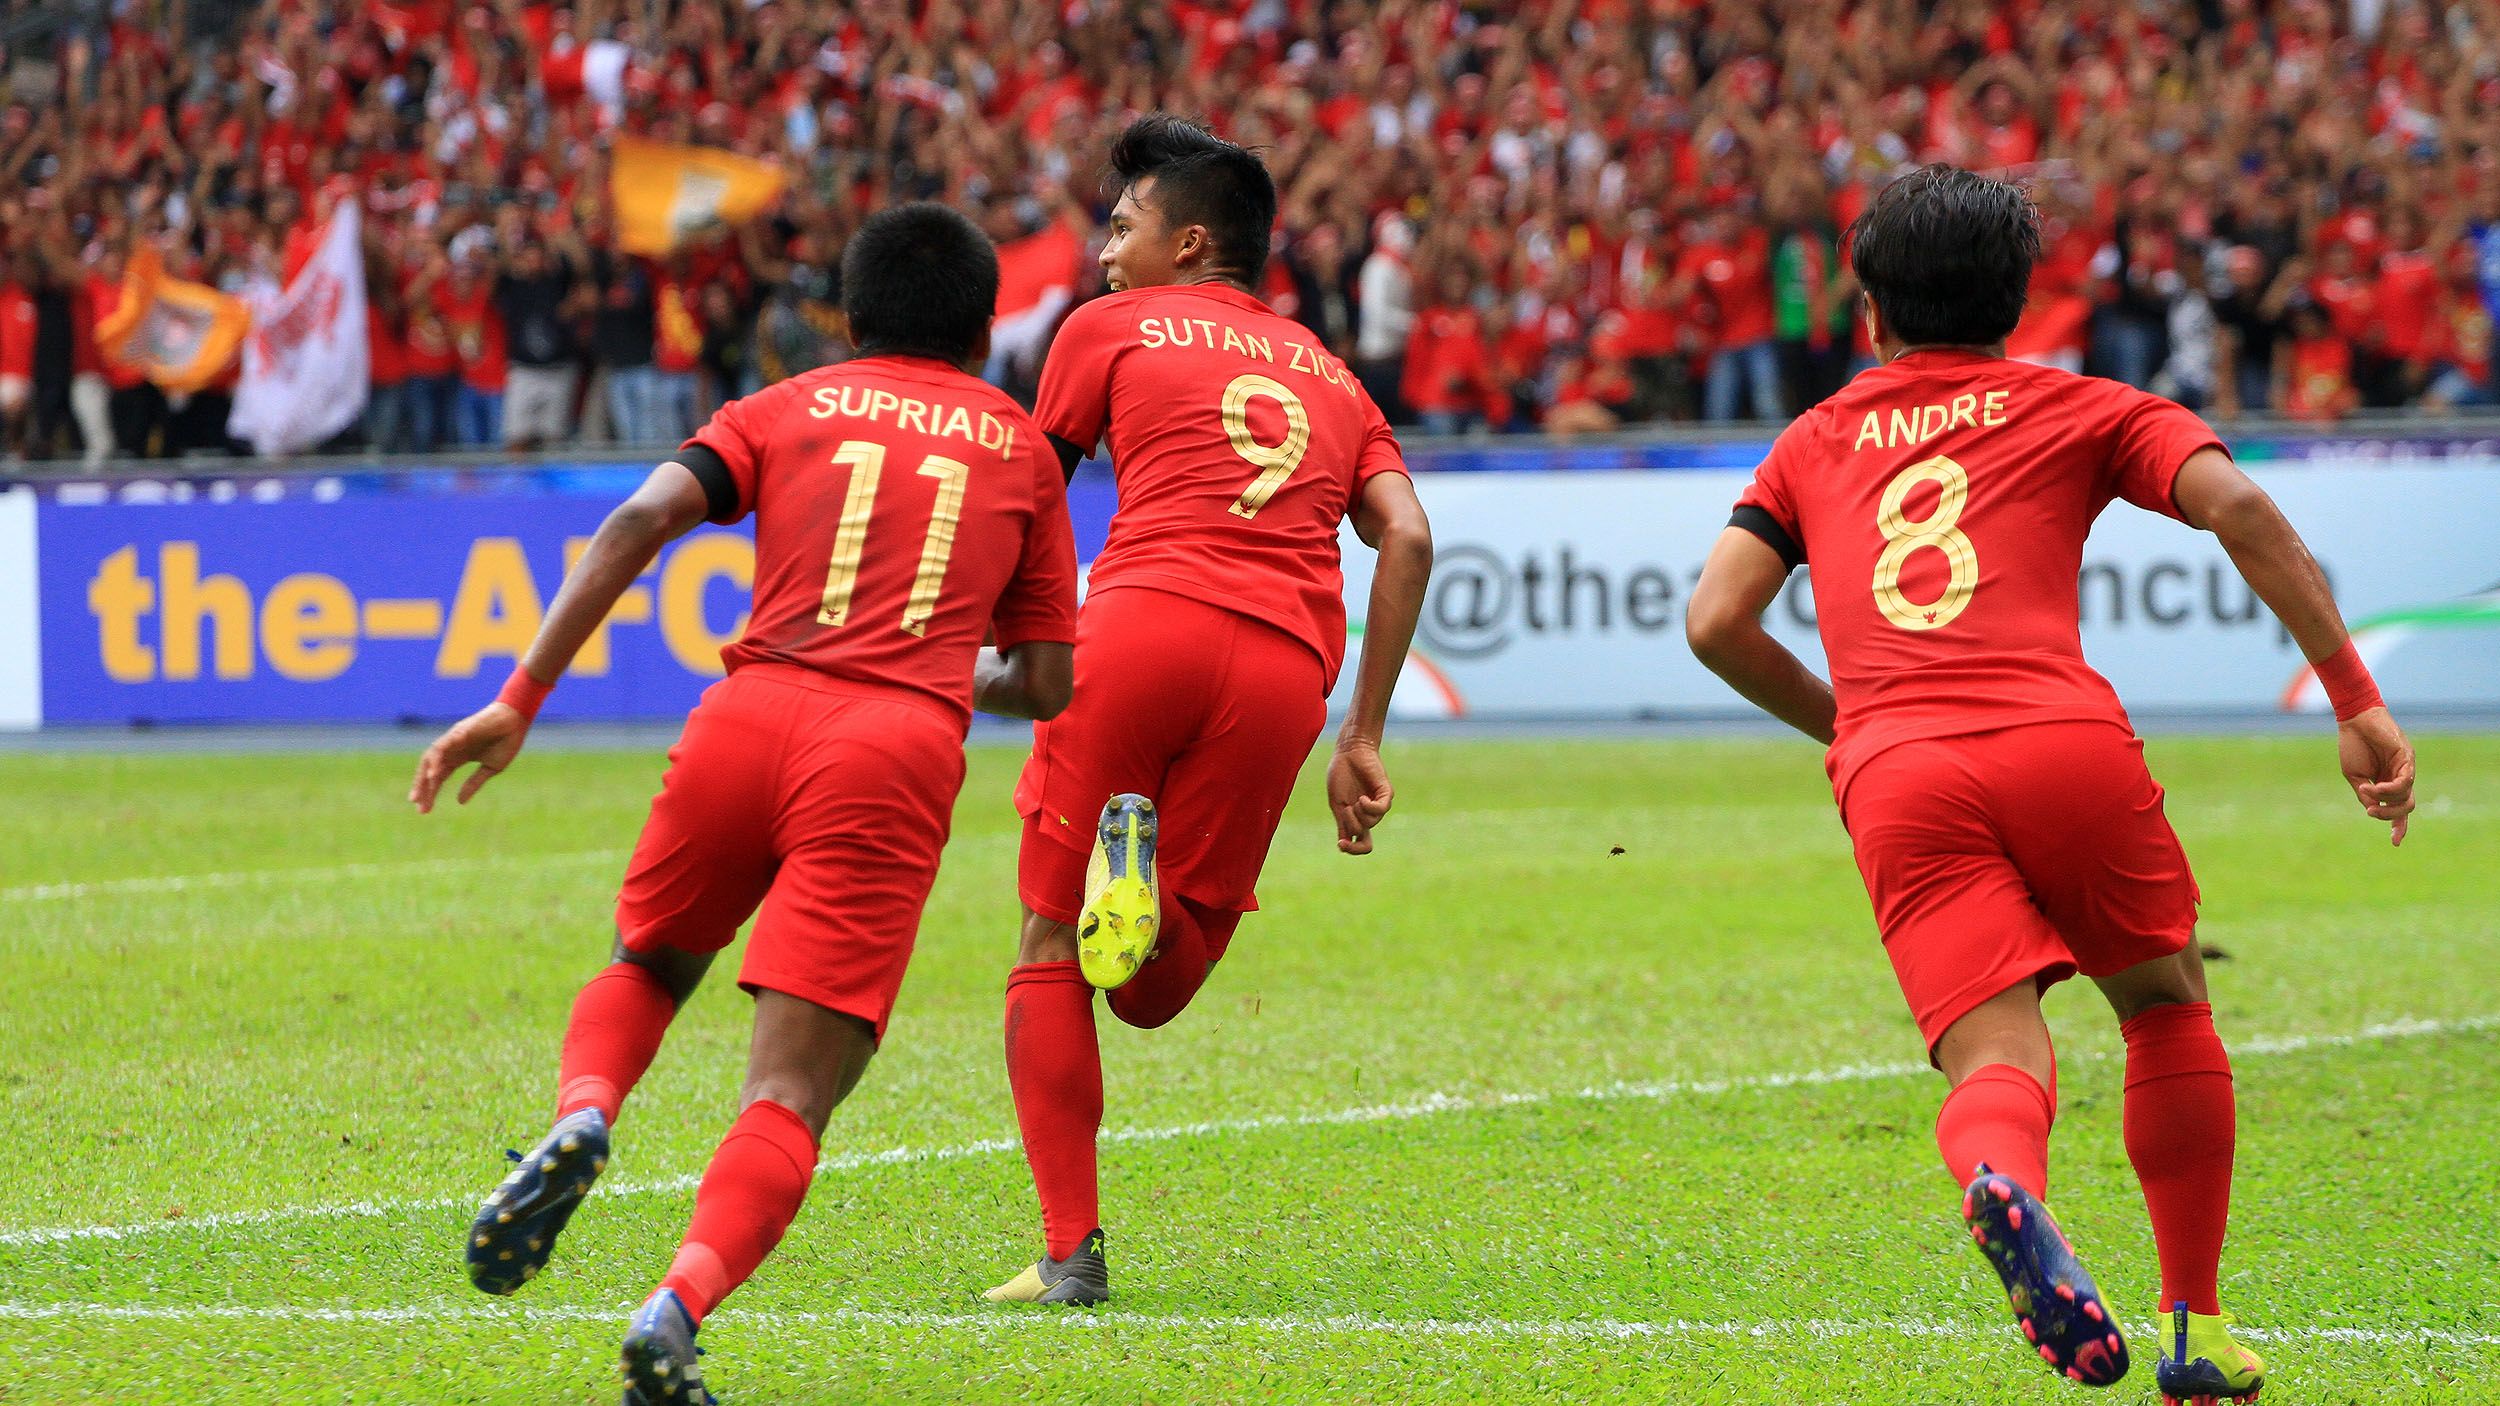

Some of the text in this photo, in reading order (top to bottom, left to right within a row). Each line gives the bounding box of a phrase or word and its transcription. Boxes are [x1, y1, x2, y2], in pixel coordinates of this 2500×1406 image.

[1138, 316, 1357, 398] SUTAN ZICO
[808, 385, 1015, 462] SUPRIADI
[1220, 373, 1311, 520] 9
[1854, 391, 2010, 452] ANDRE
[816, 440, 970, 639] 11
[1871, 454, 1979, 632] 8
